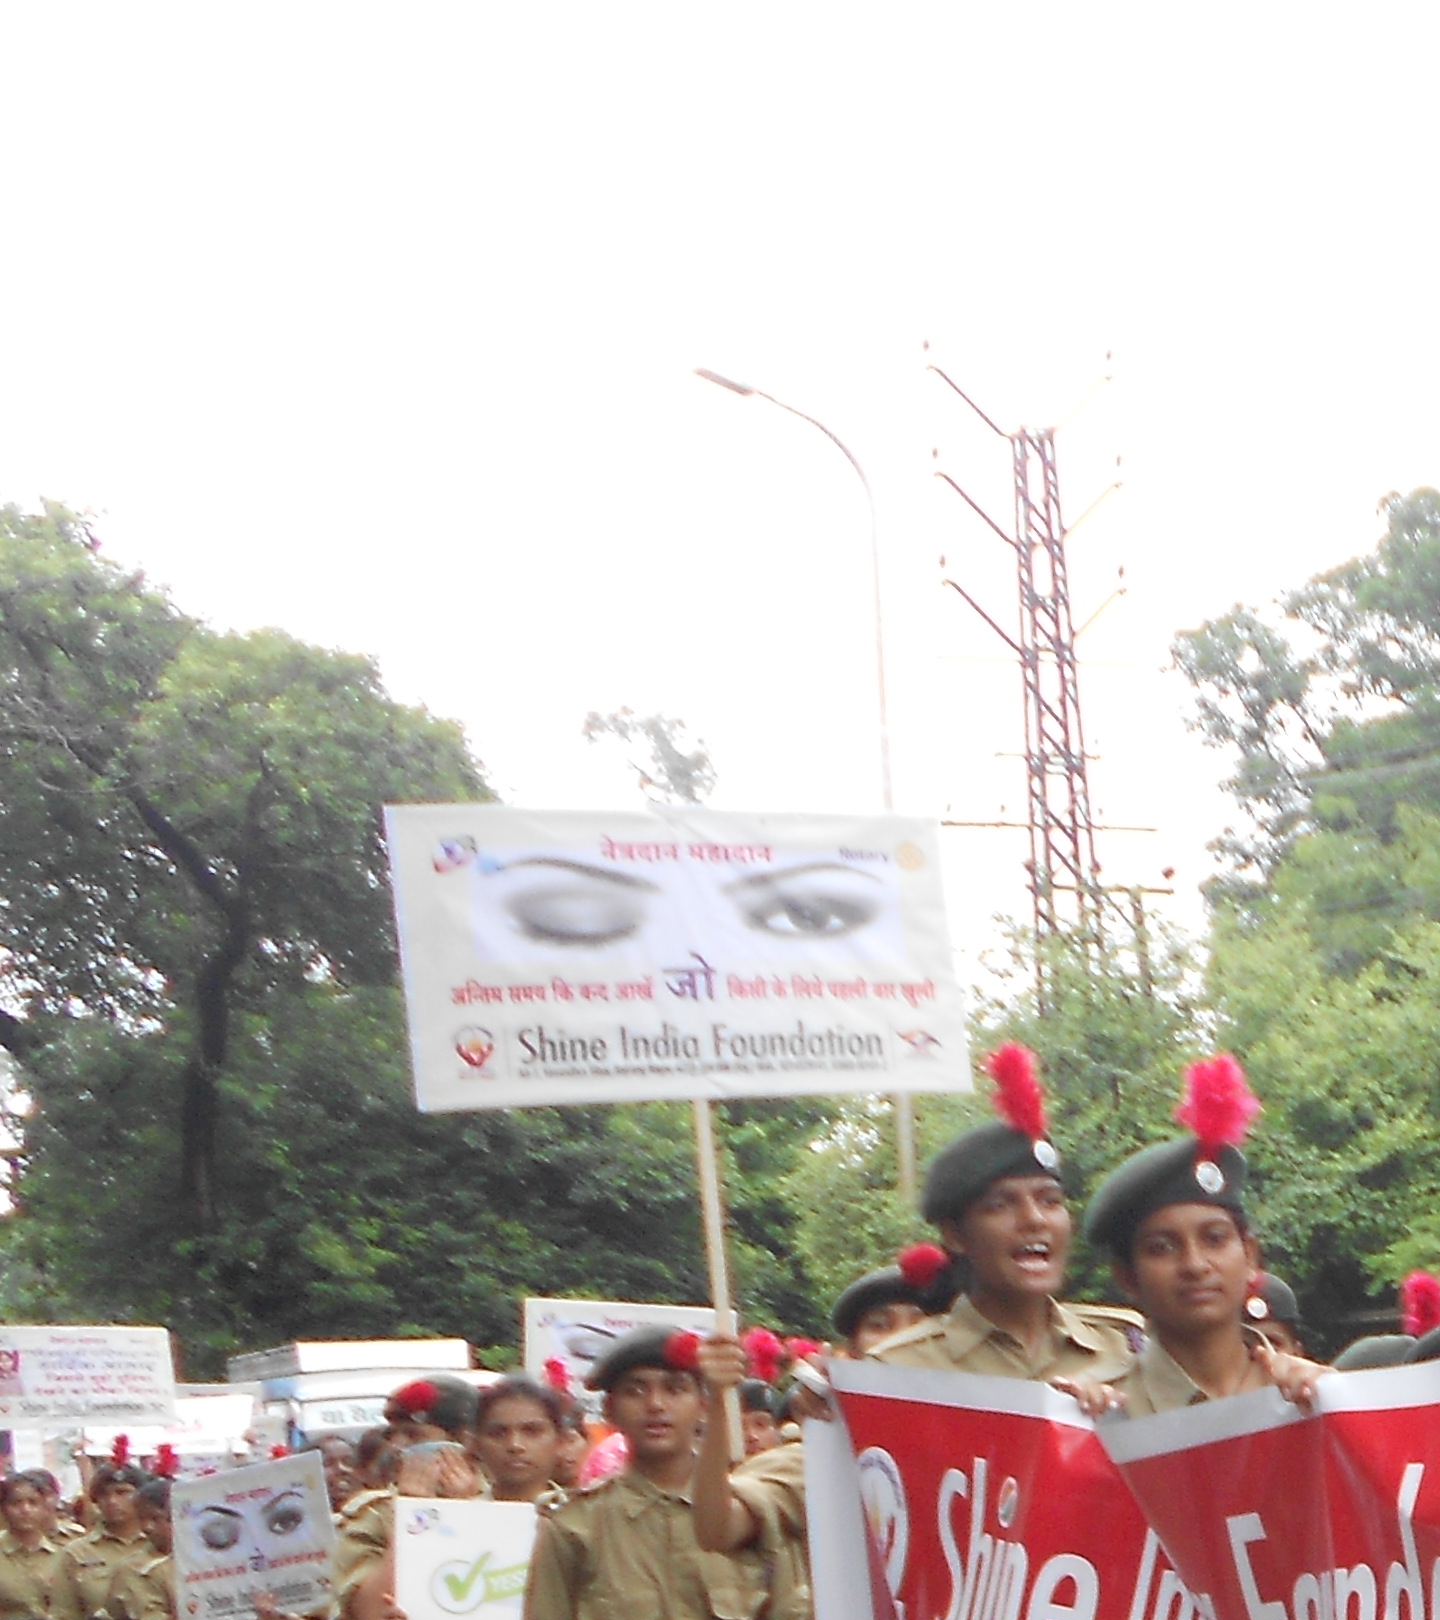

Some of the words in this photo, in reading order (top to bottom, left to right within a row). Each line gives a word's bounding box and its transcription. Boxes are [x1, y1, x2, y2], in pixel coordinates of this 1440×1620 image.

[662, 951, 717, 1002] जो
[518, 1025, 608, 1065] Shine
[620, 1019, 702, 1061] India
[712, 1018, 885, 1060] Foundation
